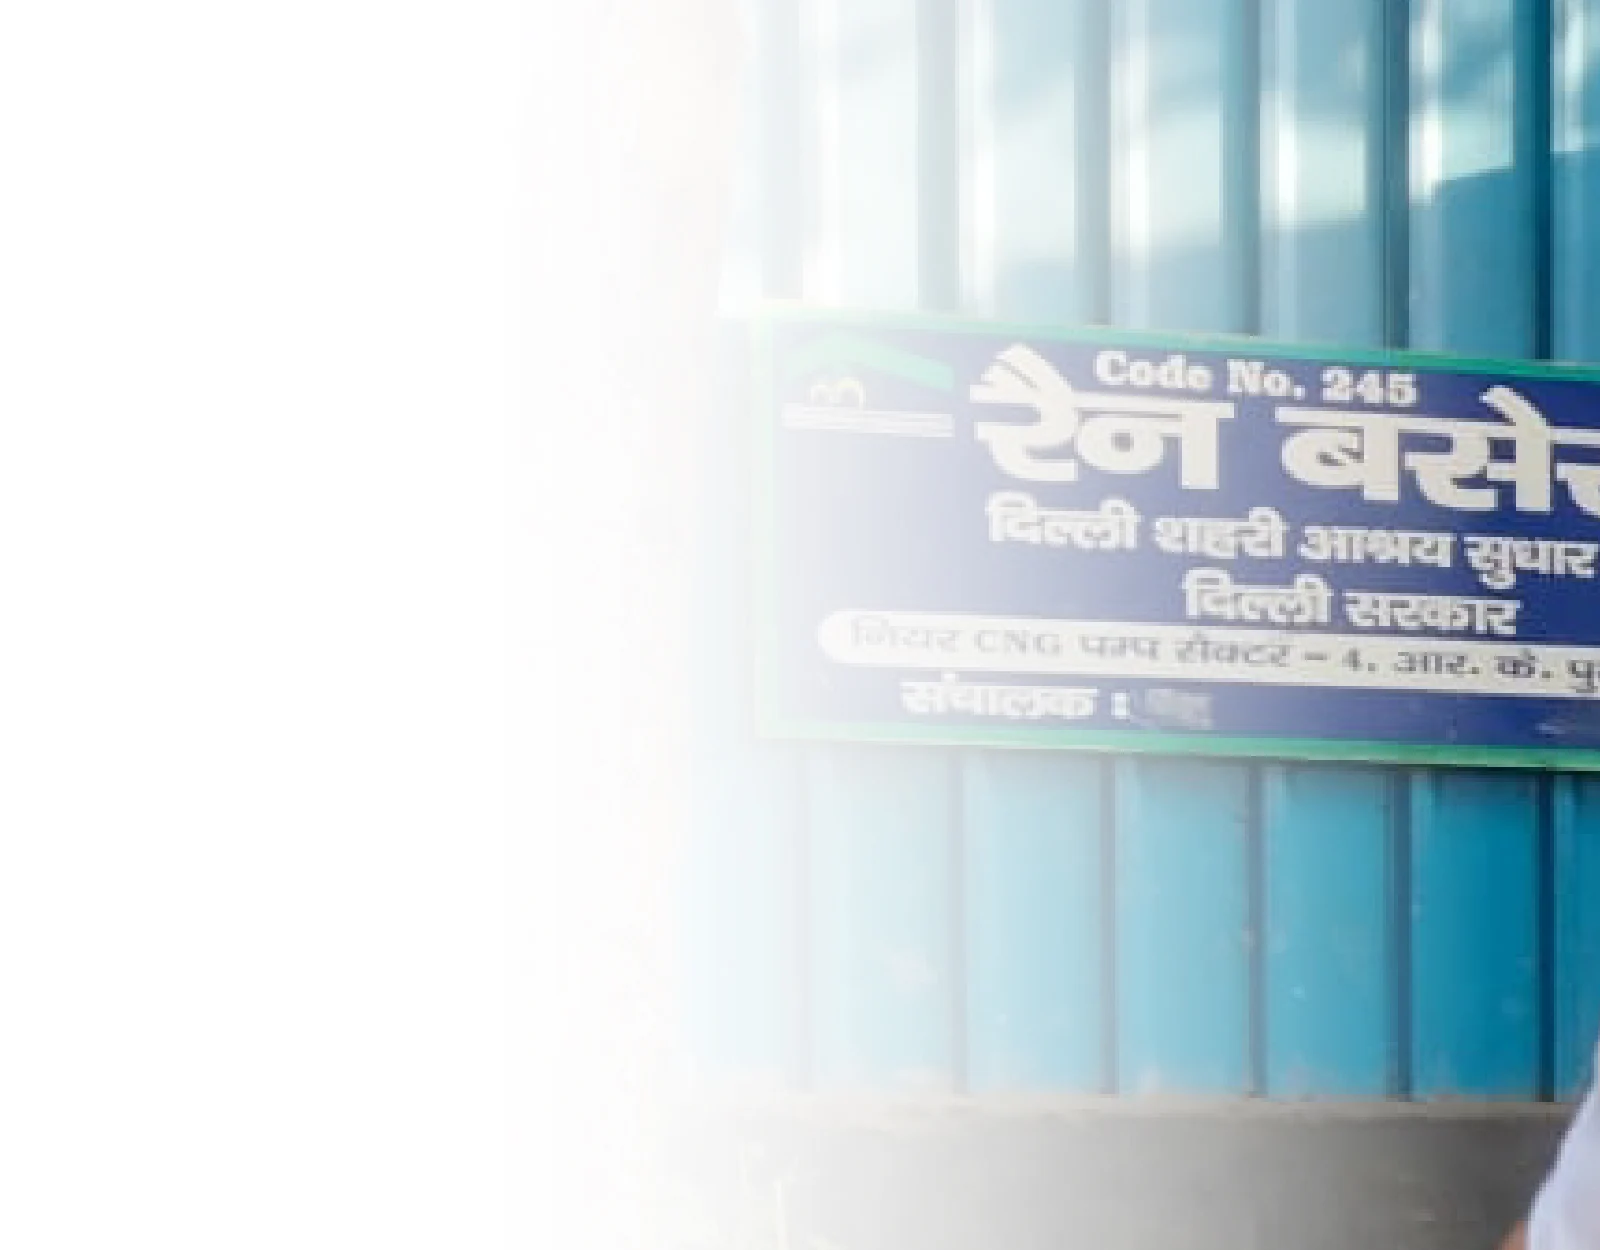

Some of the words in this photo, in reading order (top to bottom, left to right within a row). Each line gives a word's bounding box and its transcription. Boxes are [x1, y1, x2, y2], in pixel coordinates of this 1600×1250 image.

[1094, 350, 1213, 390] Code
[1226, 358, 1306, 399] No.
[1321, 367, 1418, 405] 245
[969, 343, 1235, 489] रैन
[984, 492, 1140, 550] दिल्ली
[1154, 506, 1287, 558] शहरी
[1299, 525, 1456, 568] आश्रय
[1464, 535, 1600, 590] सुधार
[1181, 567, 1334, 623] दिल्ली
[1344, 593, 1521, 635] सरकार
[974, 628, 1062, 657] CNG
